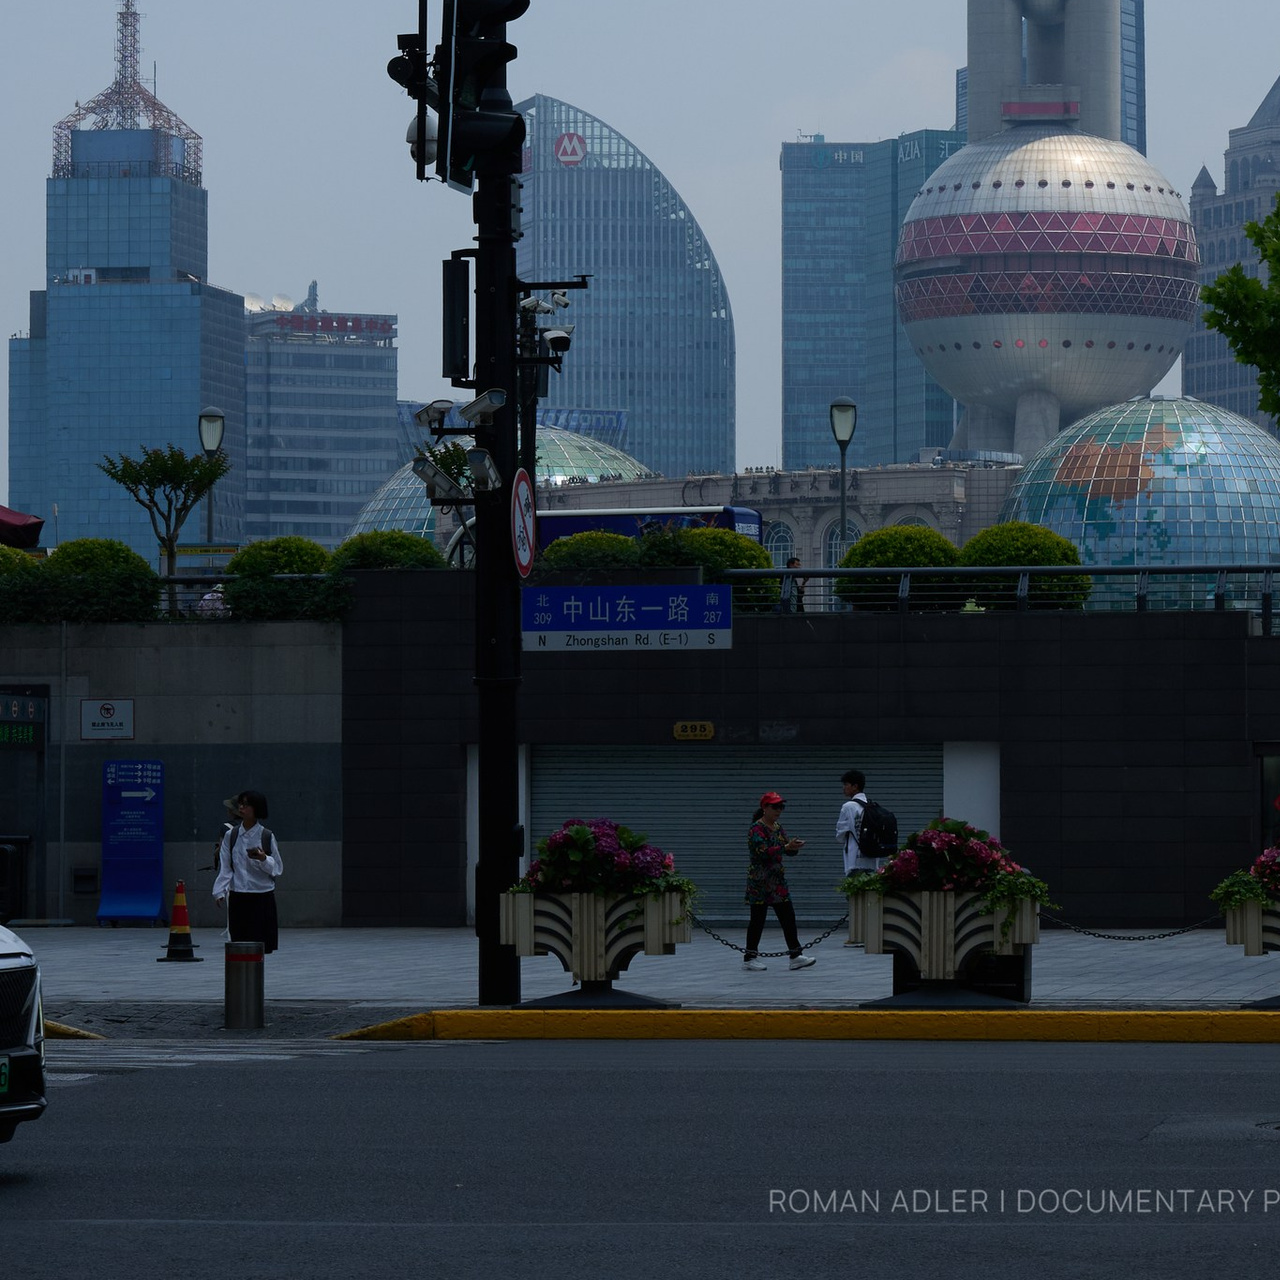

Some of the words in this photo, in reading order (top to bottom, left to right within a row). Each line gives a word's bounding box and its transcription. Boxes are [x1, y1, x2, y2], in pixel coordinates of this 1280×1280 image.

[834, 150, 864, 164] 中国
[898, 140, 921, 163] AZIA
[536, 593, 550, 607] 北
[706, 592, 719, 606] 南
[563, 594, 689, 623] 中山东一路
[533, 612, 552, 625] 309
[703, 611, 722, 624] 287
[538, 635, 546, 647] N
[565, 634, 628, 648] Zhongshan
[635, 634, 652, 646] Rd.
[658, 632, 689, 646] (E-1)
[708, 633, 715, 645] S
[681, 724, 707, 733] 295
